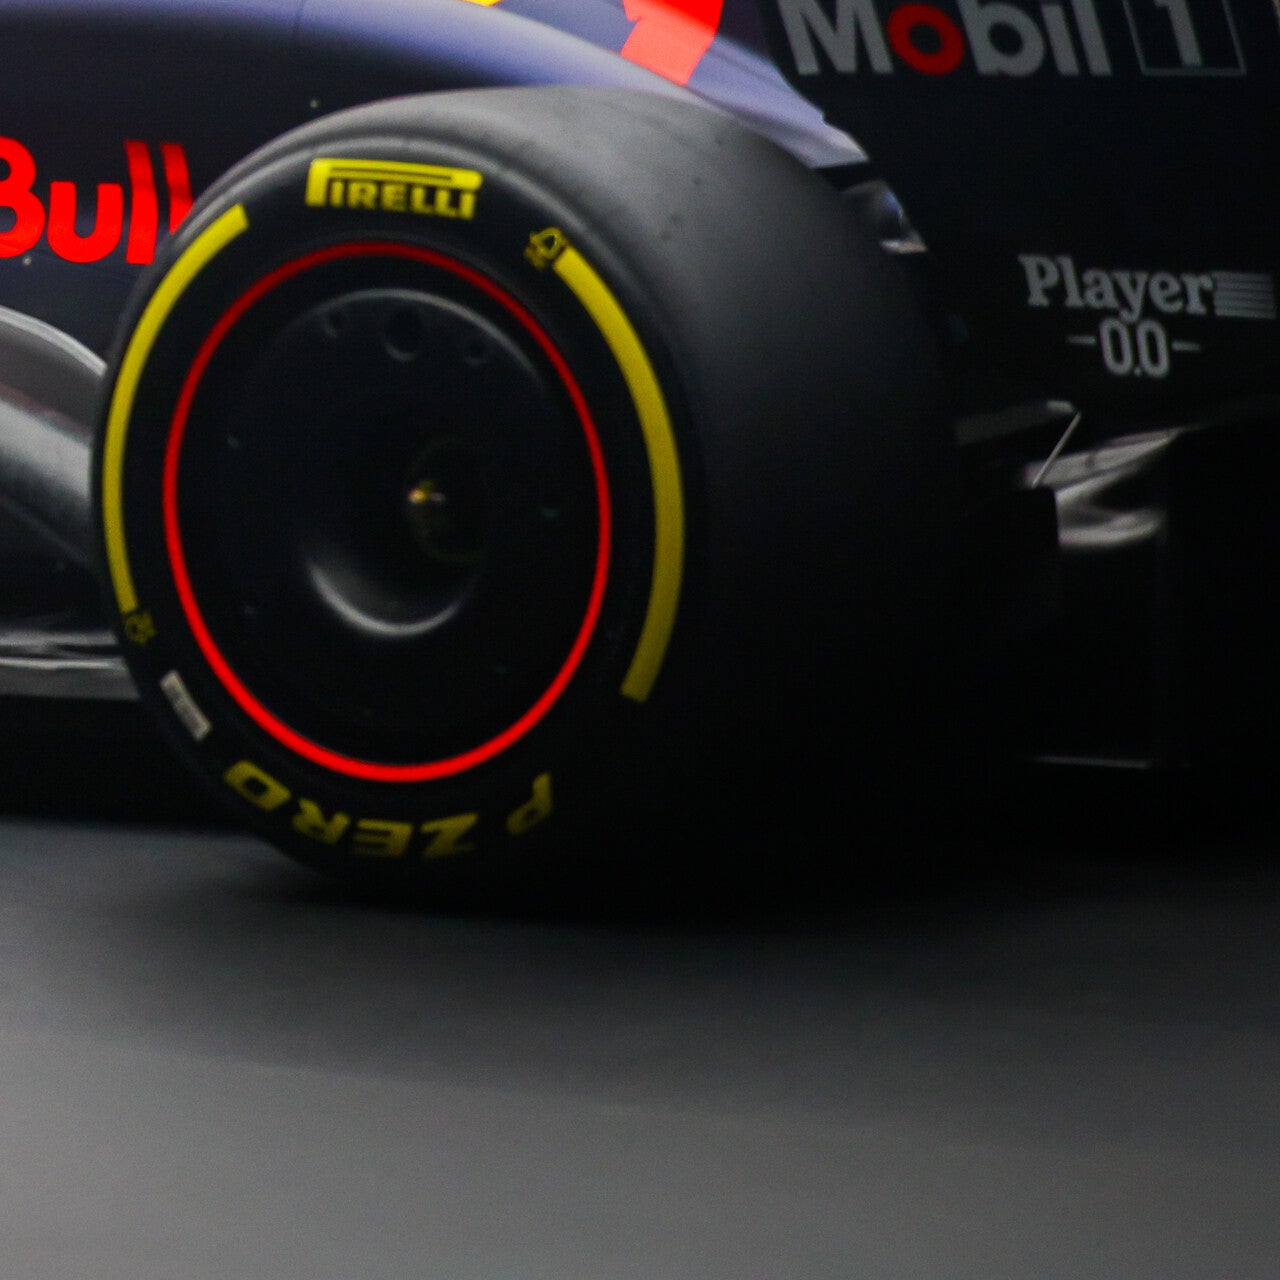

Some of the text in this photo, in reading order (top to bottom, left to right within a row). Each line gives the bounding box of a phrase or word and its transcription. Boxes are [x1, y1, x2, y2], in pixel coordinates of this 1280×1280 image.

[304, 157, 483, 218] PIRELLI
[1018, 253, 1214, 322] Player
[223, 760, 554, 860] P ZERO
